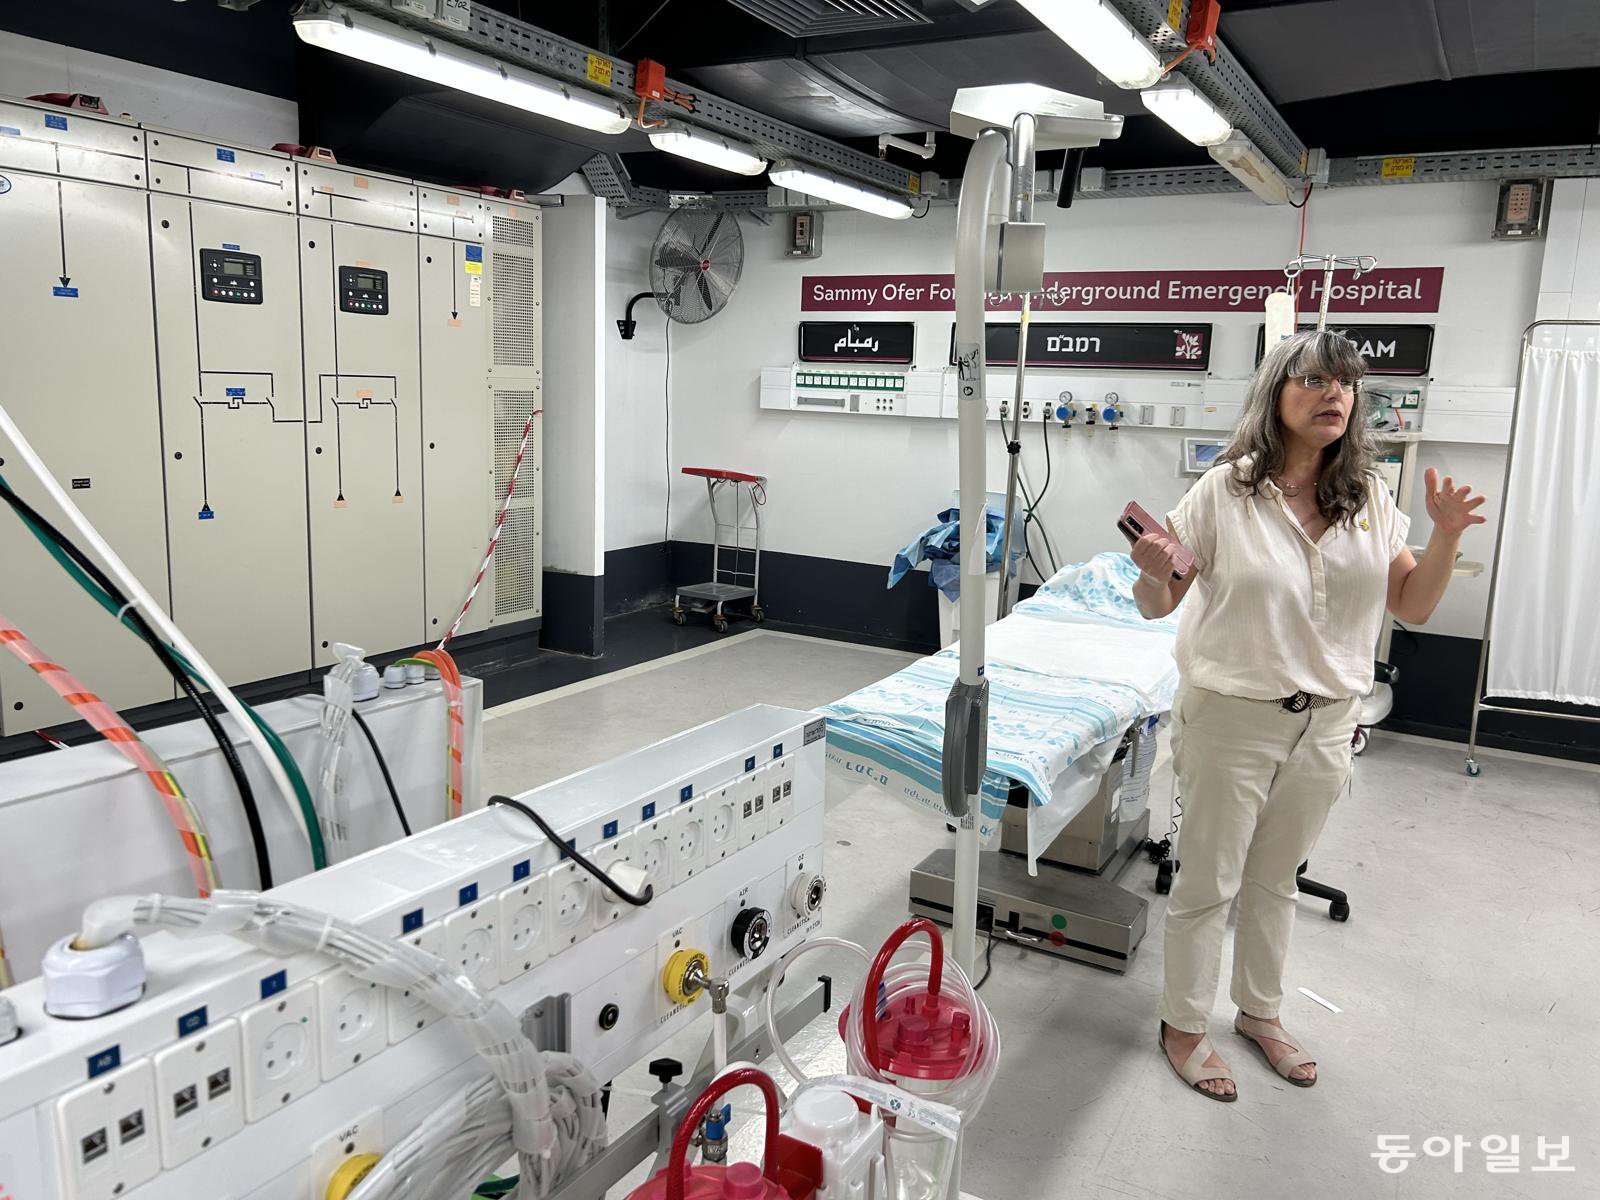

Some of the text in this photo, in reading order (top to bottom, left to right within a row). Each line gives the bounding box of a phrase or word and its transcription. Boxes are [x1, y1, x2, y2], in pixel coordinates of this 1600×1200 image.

[813, 284, 878, 306] Sammy
[882, 283, 925, 300] Ofer
[1019, 281, 1160, 306] derground
[1310, 278, 1422, 306] Hospital
[834, 328, 879, 352] رمبام
[338, 1124, 359, 1142] VAC
